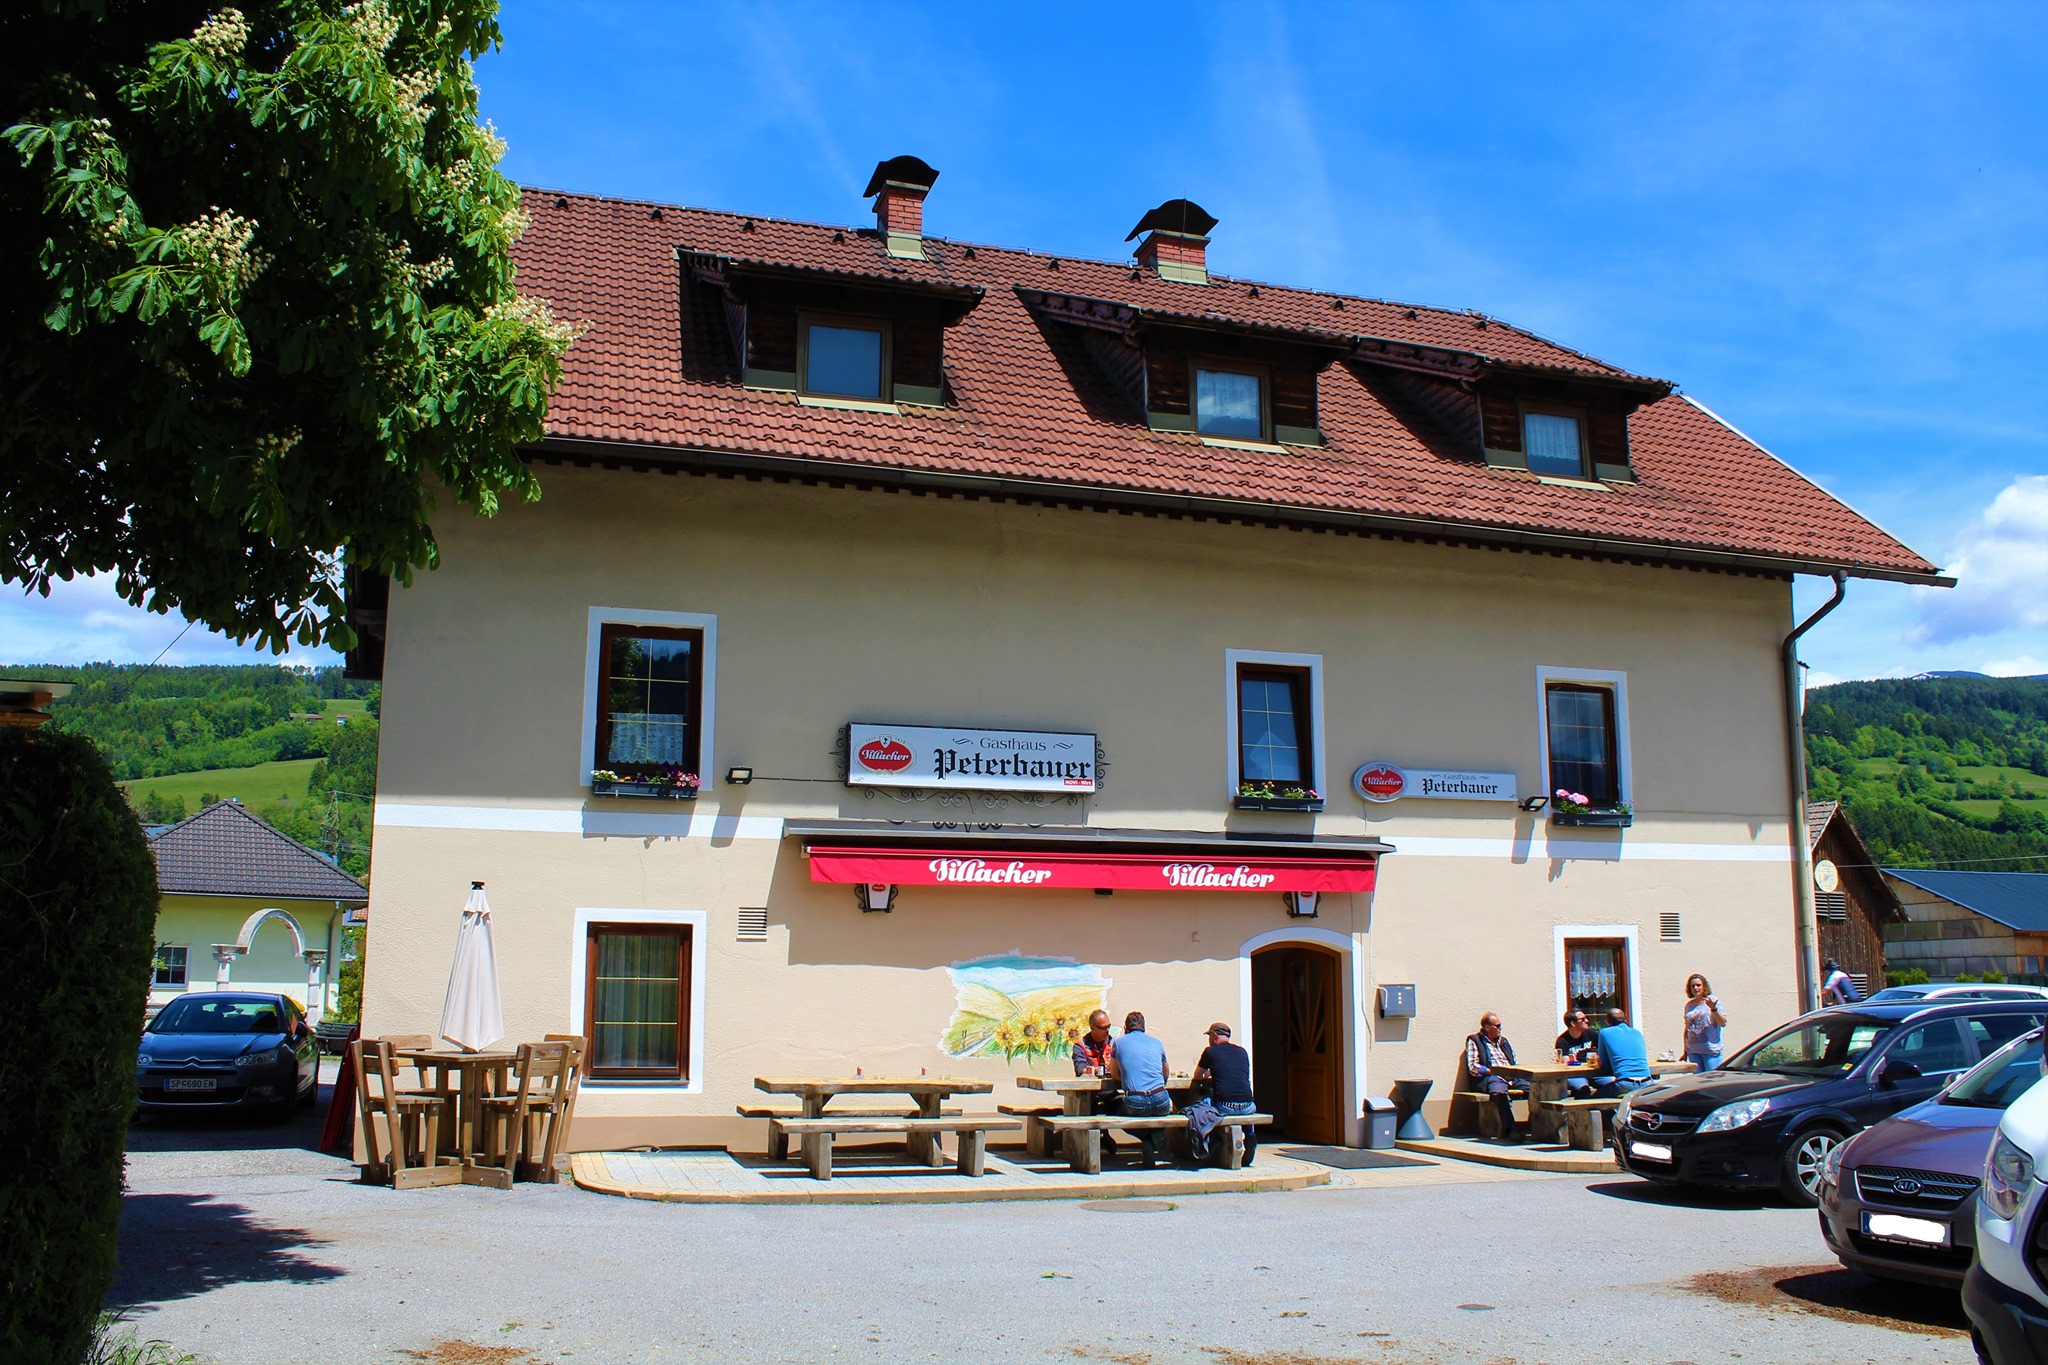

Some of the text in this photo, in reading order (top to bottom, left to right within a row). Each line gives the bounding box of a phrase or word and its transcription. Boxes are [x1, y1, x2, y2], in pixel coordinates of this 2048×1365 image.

[980, 737, 1046, 751] Gasthaus
[861, 749, 910, 761] Villacher
[933, 748, 1092, 780] Peterbauer
[1364, 776, 1402, 786] Villacher
[1422, 778, 1498, 795] Peterbauer
[929, 858, 1052, 884] Villacher
[1162, 863, 1275, 888] Villacher
[1897, 1180, 1916, 1191] KIA
